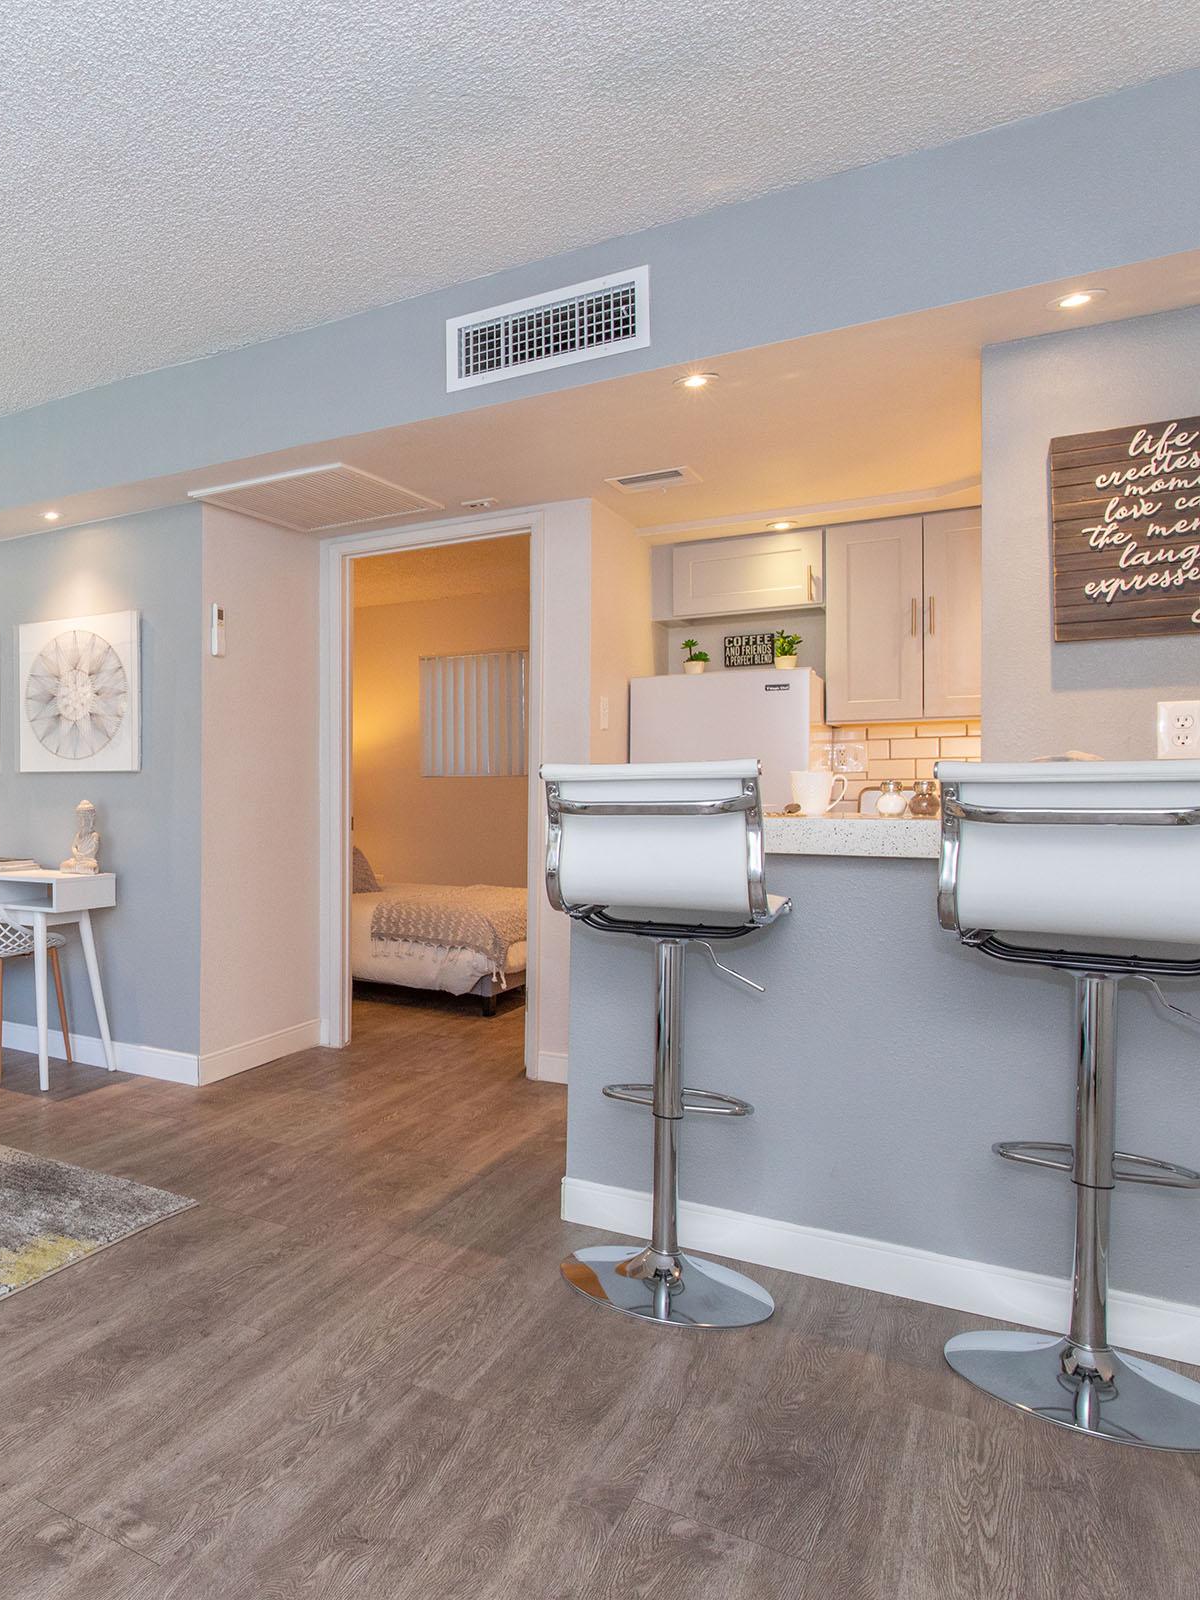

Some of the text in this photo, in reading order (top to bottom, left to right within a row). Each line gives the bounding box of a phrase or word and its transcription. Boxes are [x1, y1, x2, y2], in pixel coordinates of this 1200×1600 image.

[1128, 422, 1200, 460] life
[1095, 447, 1200, 488] creates
[1123, 475, 1200, 497] mom
[1104, 496, 1162, 523] love
[1081, 522, 1132, 549] the
[725, 634, 772, 647] COFFEE
[725, 644, 772, 658] AND FRIENDS
[730, 654, 753, 666] PERFECT
